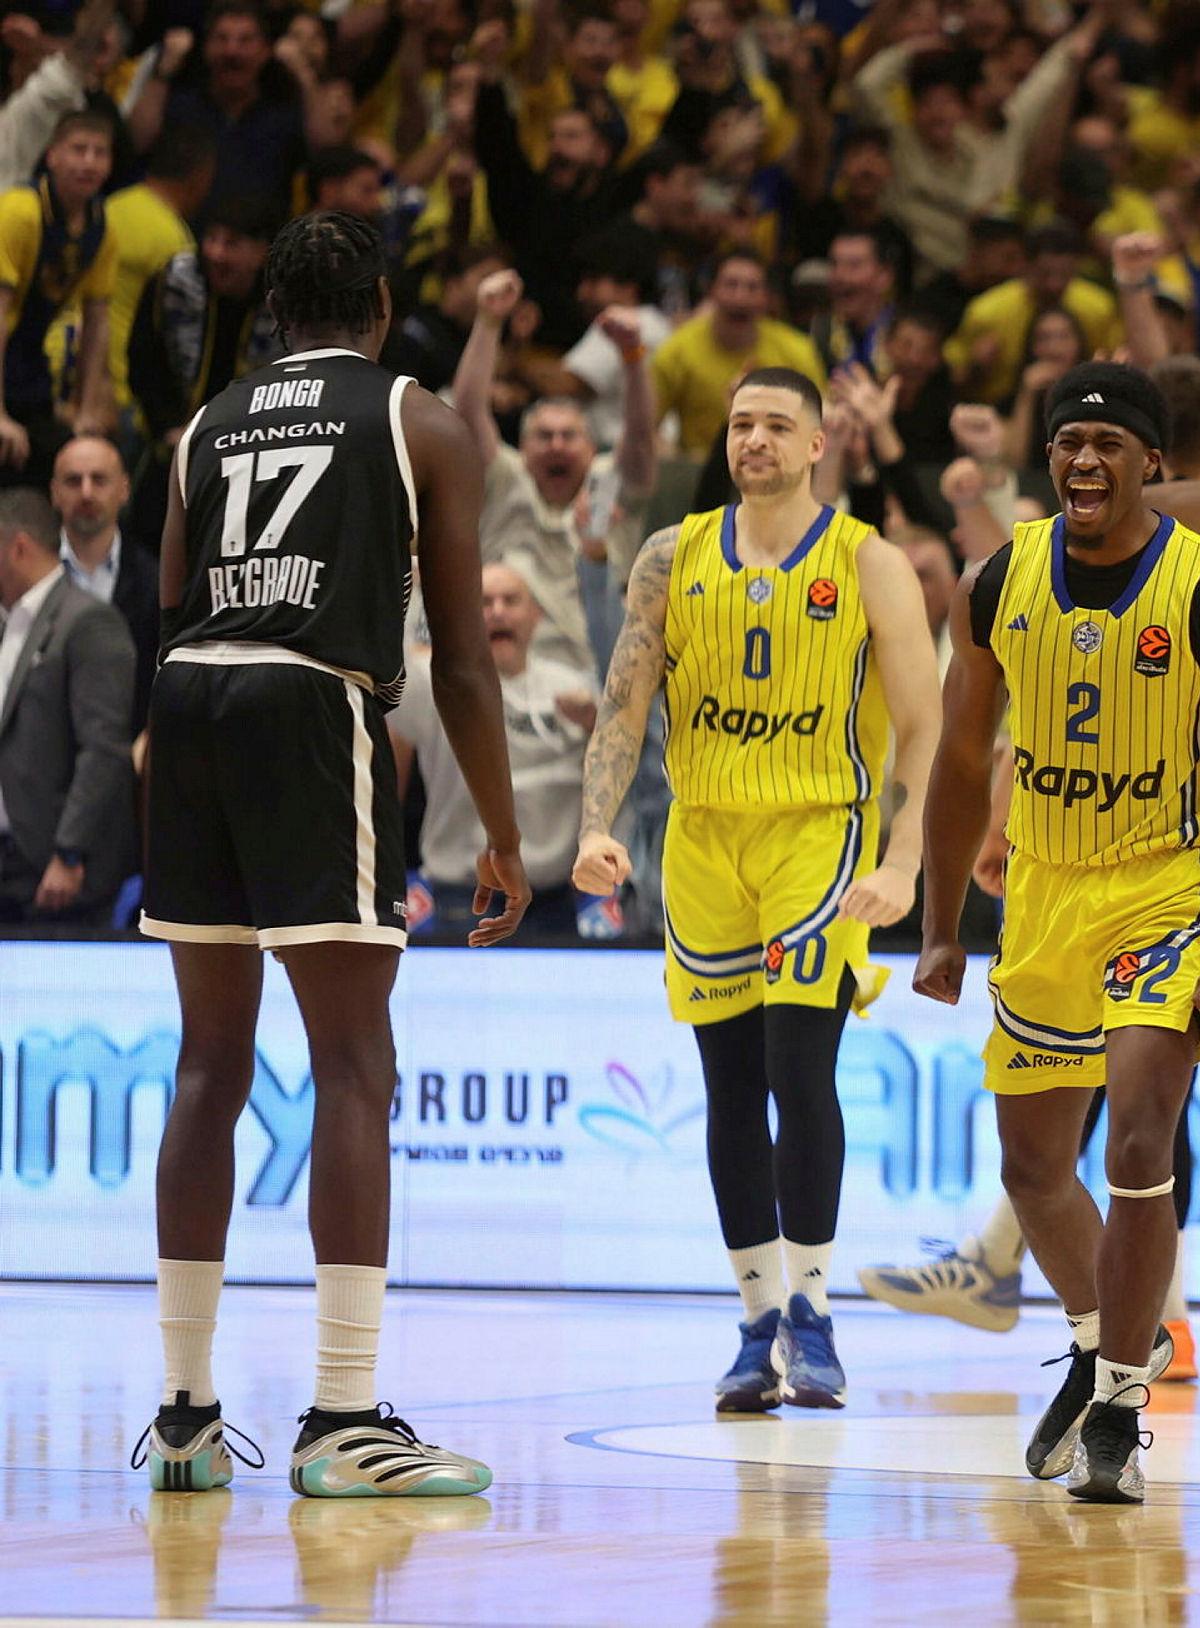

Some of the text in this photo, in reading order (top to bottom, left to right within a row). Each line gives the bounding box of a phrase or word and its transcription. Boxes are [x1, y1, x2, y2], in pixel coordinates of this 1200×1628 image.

[249, 379, 325, 415] BONGA
[214, 421, 346, 450] CHANGAN
[221, 445, 335, 558] 17
[743, 626, 771, 681] 0
[692, 695, 825, 745] Rapyd
[1066, 682, 1100, 744] 2
[1014, 746, 1166, 813] Rapyd
[709, 977, 751, 1000] Rapyd
[1139, 947, 1181, 1003] 2
[1033, 1053, 1083, 1068] Rapyd
